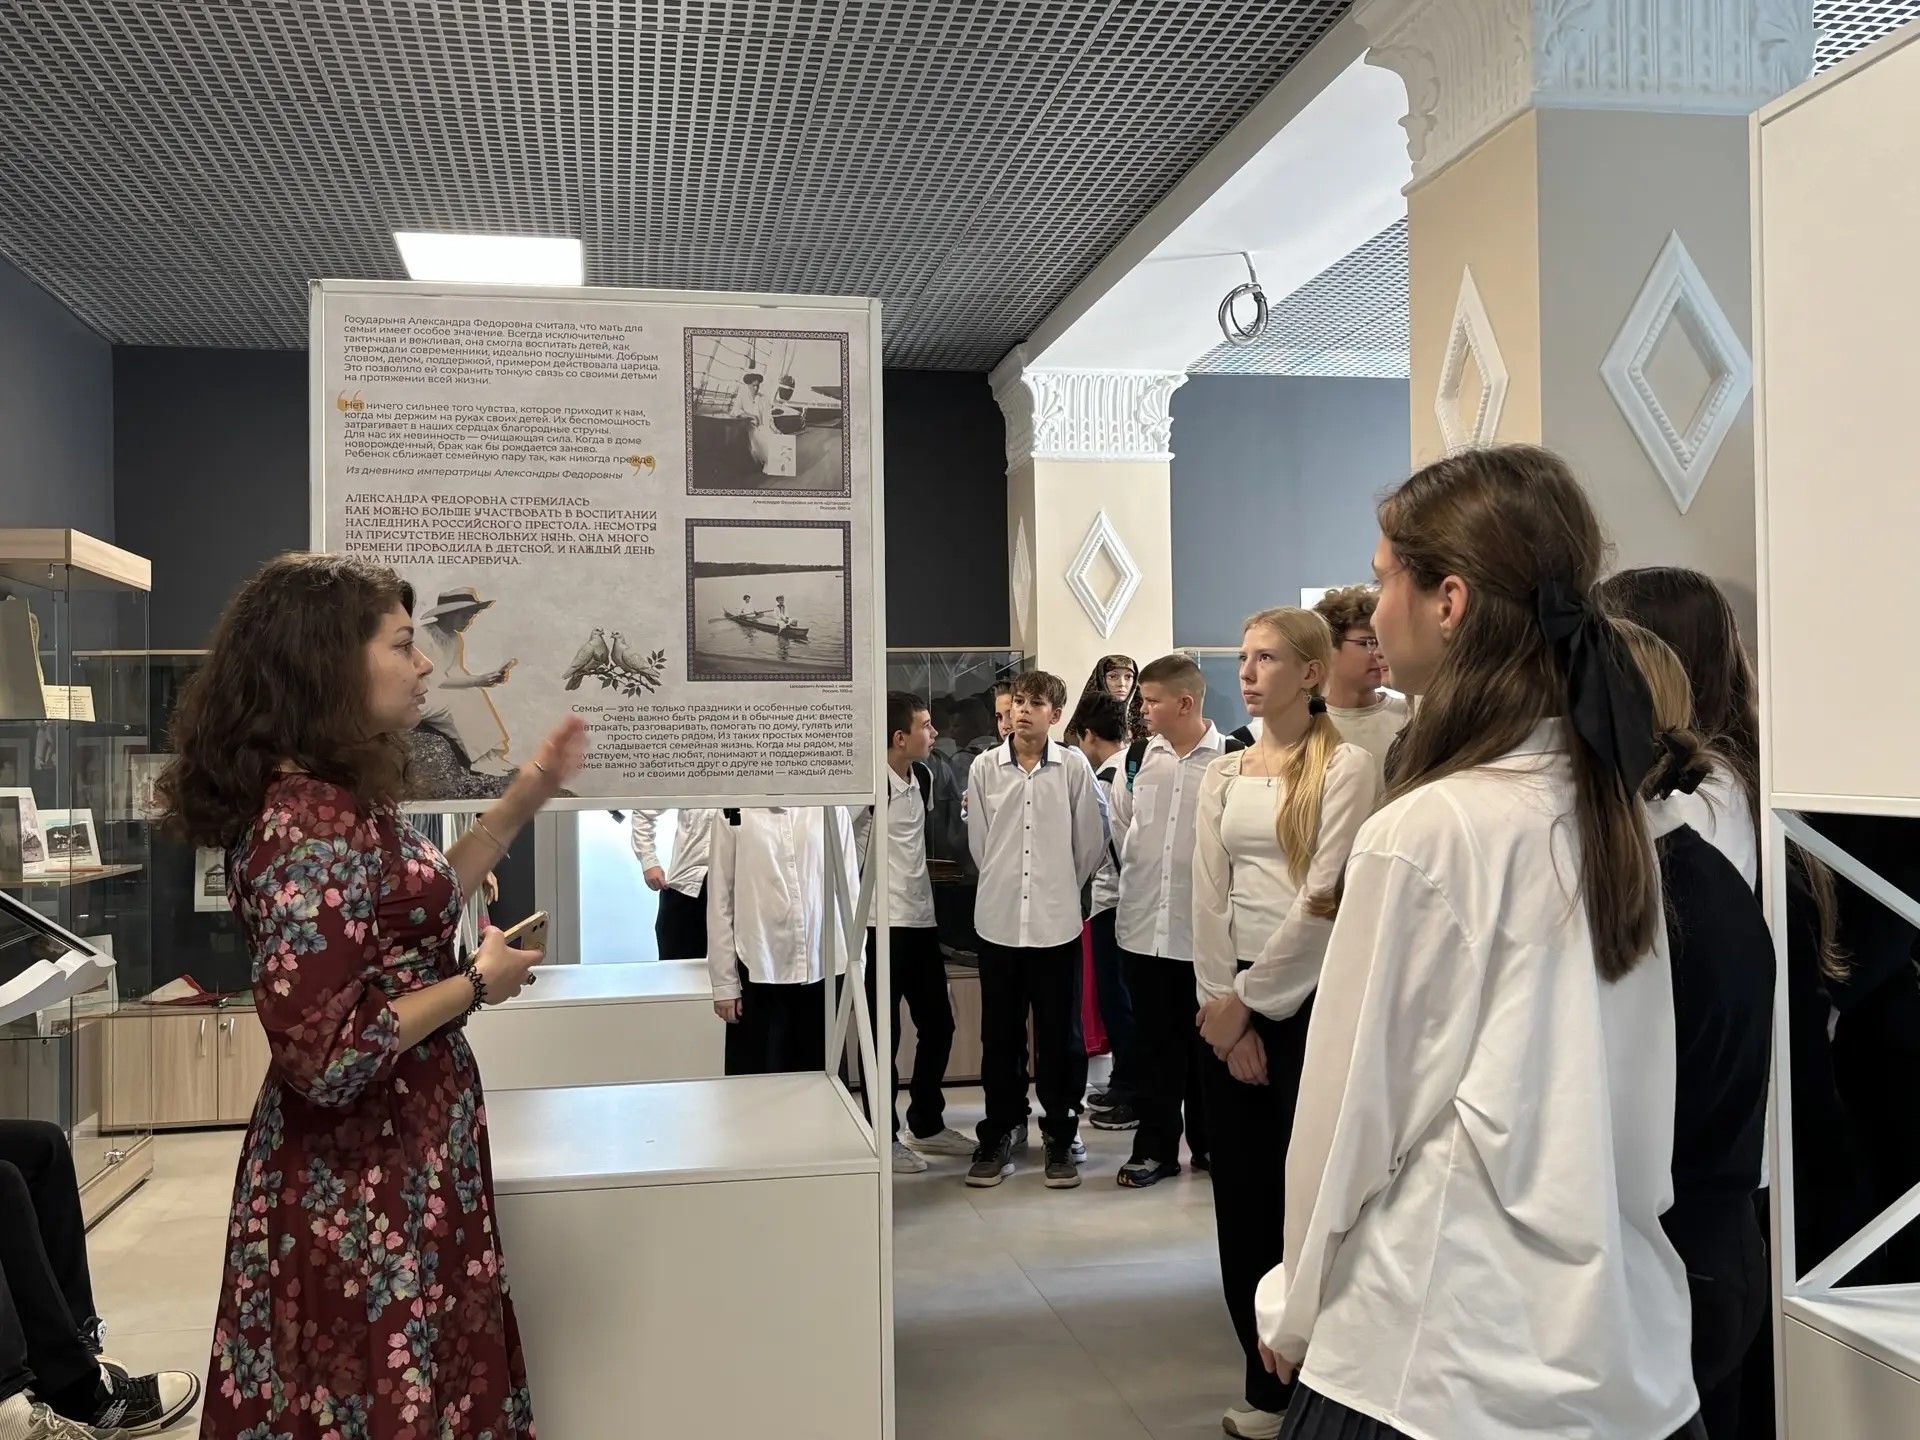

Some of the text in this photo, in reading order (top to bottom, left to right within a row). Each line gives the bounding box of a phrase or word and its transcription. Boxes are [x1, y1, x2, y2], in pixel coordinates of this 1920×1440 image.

[344, 314, 405, 326] Государыня
[407, 316, 470, 328] Александра
[473, 318, 532, 330] Федоровна
[580, 323, 596, 331] что
[624, 324, 642, 333] для
[343, 326, 376, 334] семьи
[379, 327, 411, 335] имеет
[413, 326, 450, 336] особое
[507, 329, 542, 339] Всегда
[545, 331, 624, 340] исключительно
[343, 336, 396, 344] тактичная
[486, 340, 522, 348] смогла
[525, 341, 577, 349] воспитать
[343, 346, 407, 356] утверждали
[492, 349, 542, 359] идеально
[616, 351, 658, 362] Добрым
[496, 359, 550, 369] примером
[552, 359, 617, 370] действовала
[344, 363, 657, 380] Это позволило сохранить тонкую связь своими детьми
[359, 375, 424, 384] протяжении
[428, 374, 452, 383] всей
[344, 400, 364, 409] Нет
[366, 402, 403, 410] ничего
[405, 403, 449, 411] сильнее
[452, 404, 473, 412] того
[520, 406, 561, 415] которое
[564, 407, 612, 416] приходит
[344, 412, 373, 421] когда
[393, 413, 436, 422] держим
[455, 414, 484, 424] руках
[486, 415, 516, 423] своих
[568, 415, 650, 427] беспомощность
[344, 422, 408, 432] затрагивает
[419, 423, 453, 431] наших
[455, 424, 498, 434] сердцах
[500, 423, 570, 435] благородные
[343, 430, 364, 440] Для
[403, 432, 465, 441] невинность
[480, 434, 544, 443] очищающая
[575, 434, 604, 444] Когда
[614, 437, 641, 445] доме
[437, 441, 462, 452] брак
[502, 444, 556, 453] рождается
[345, 449, 390, 460] Ребенок
[392, 450, 442, 459] сближает
[445, 451, 498, 462] семейную
[501, 453, 526, 462] пару
[549, 454, 566, 462] как
[569, 455, 610, 464] никогда
[360, 468, 622, 480] дневника императрицы Александры Федоровны
[345, 494, 589, 506] АЛЕКСАНДРА ФЕДОРОВНА СТРЕМИЛАСЬ
[345, 506, 656, 520] КАК МОЖНО БОЛЬШЕ УЧАСТВОВАТЬ ВОСПИТАНИИ
[345, 518, 656, 531] НАСЛЕДНИКА РОССИЙСКОГО НЕСМОТРЯ
[366, 531, 648, 543] ПРИСУТСТВИЕ НЕСКОЛЬКИХ ОНА МНОГО
[345, 543, 654, 555] ВРЕМЕНИ ПРОВОДИЛА КАЖДЫЙ ДЕНЬ
[383, 555, 434, 565] КУПАЛА
[571, 704, 603, 712] Семья
[687, 705, 741, 713] праздники
[752, 703, 808, 712] особенные
[602, 713, 635, 721] Очень
[671, 712, 696, 721] быть
[698, 714, 729, 723] рядом
[749, 712, 794, 721] обычные
[710, 723, 756, 731] помогать
[801, 723, 832, 732] гулять
[607, 733, 642, 742] просто
[644, 733, 679, 741] сидеть
[732, 732, 760, 740] таких
[762, 732, 802, 741] простых
[596, 742, 666, 751] складывается
[669, 740, 718, 750] семейная
[756, 740, 783, 750] Когда
[640, 760, 694, 768] заботиться
[696, 761, 720, 770] друг
[730, 761, 758, 770] друге
[775, 760, 807, 768] только
[646, 770, 685, 778] своими
[687, 768, 734, 779] добрыми
[736, 770, 773, 778] делами
[788, 768, 826, 778] каждый
